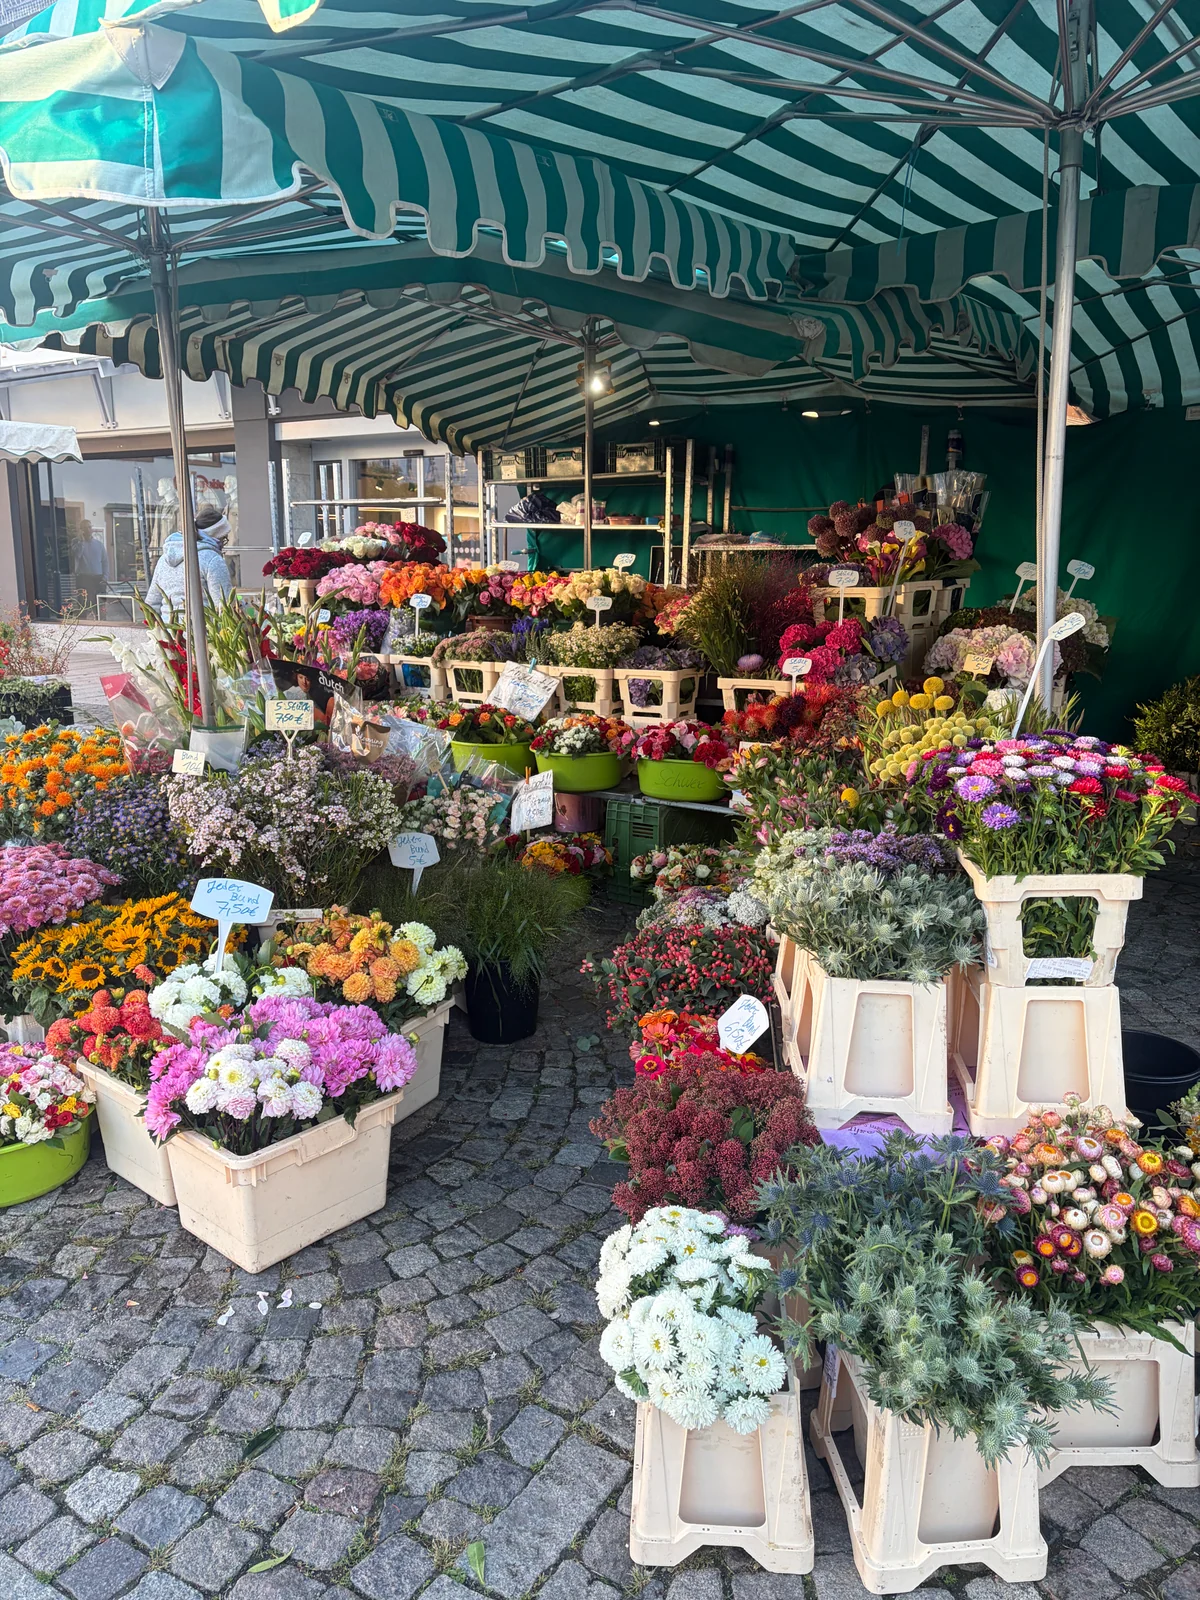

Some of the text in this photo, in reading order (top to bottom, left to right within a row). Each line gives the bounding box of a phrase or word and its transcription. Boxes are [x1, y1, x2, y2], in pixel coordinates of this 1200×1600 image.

[206, 880, 244, 894] Jeder
[229, 892, 261, 905] Bund
[215, 900, 260, 917] 7,50€
